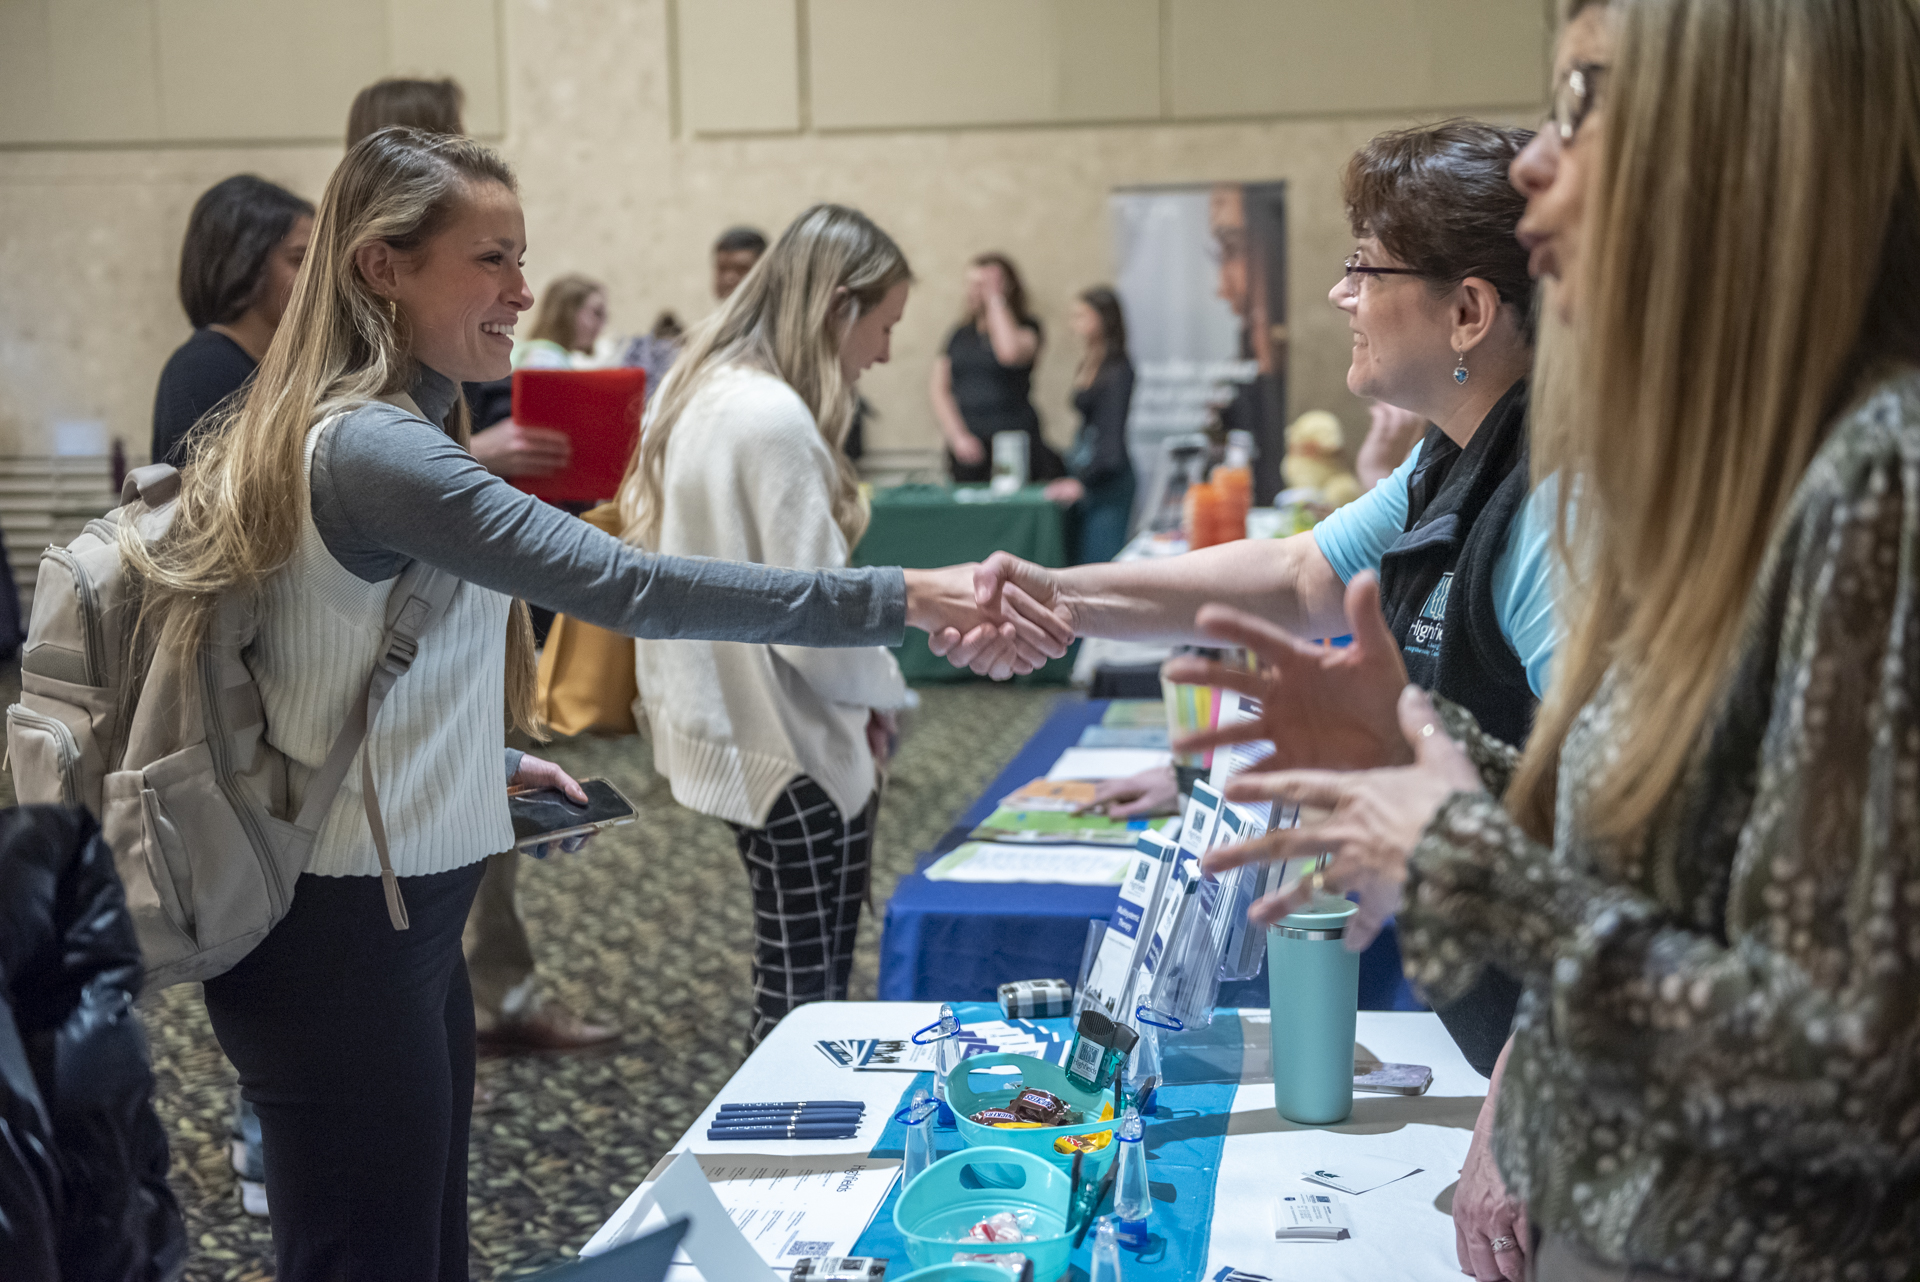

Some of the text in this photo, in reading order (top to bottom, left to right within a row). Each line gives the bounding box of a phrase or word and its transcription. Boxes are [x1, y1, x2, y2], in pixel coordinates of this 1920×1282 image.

[1073, 1057, 1097, 1075] Highfields
[1024, 1093, 1055, 1111] SNICKERS
[985, 1112, 1016, 1121] SNICKERS
[836, 1164, 867, 1193] Highfields
